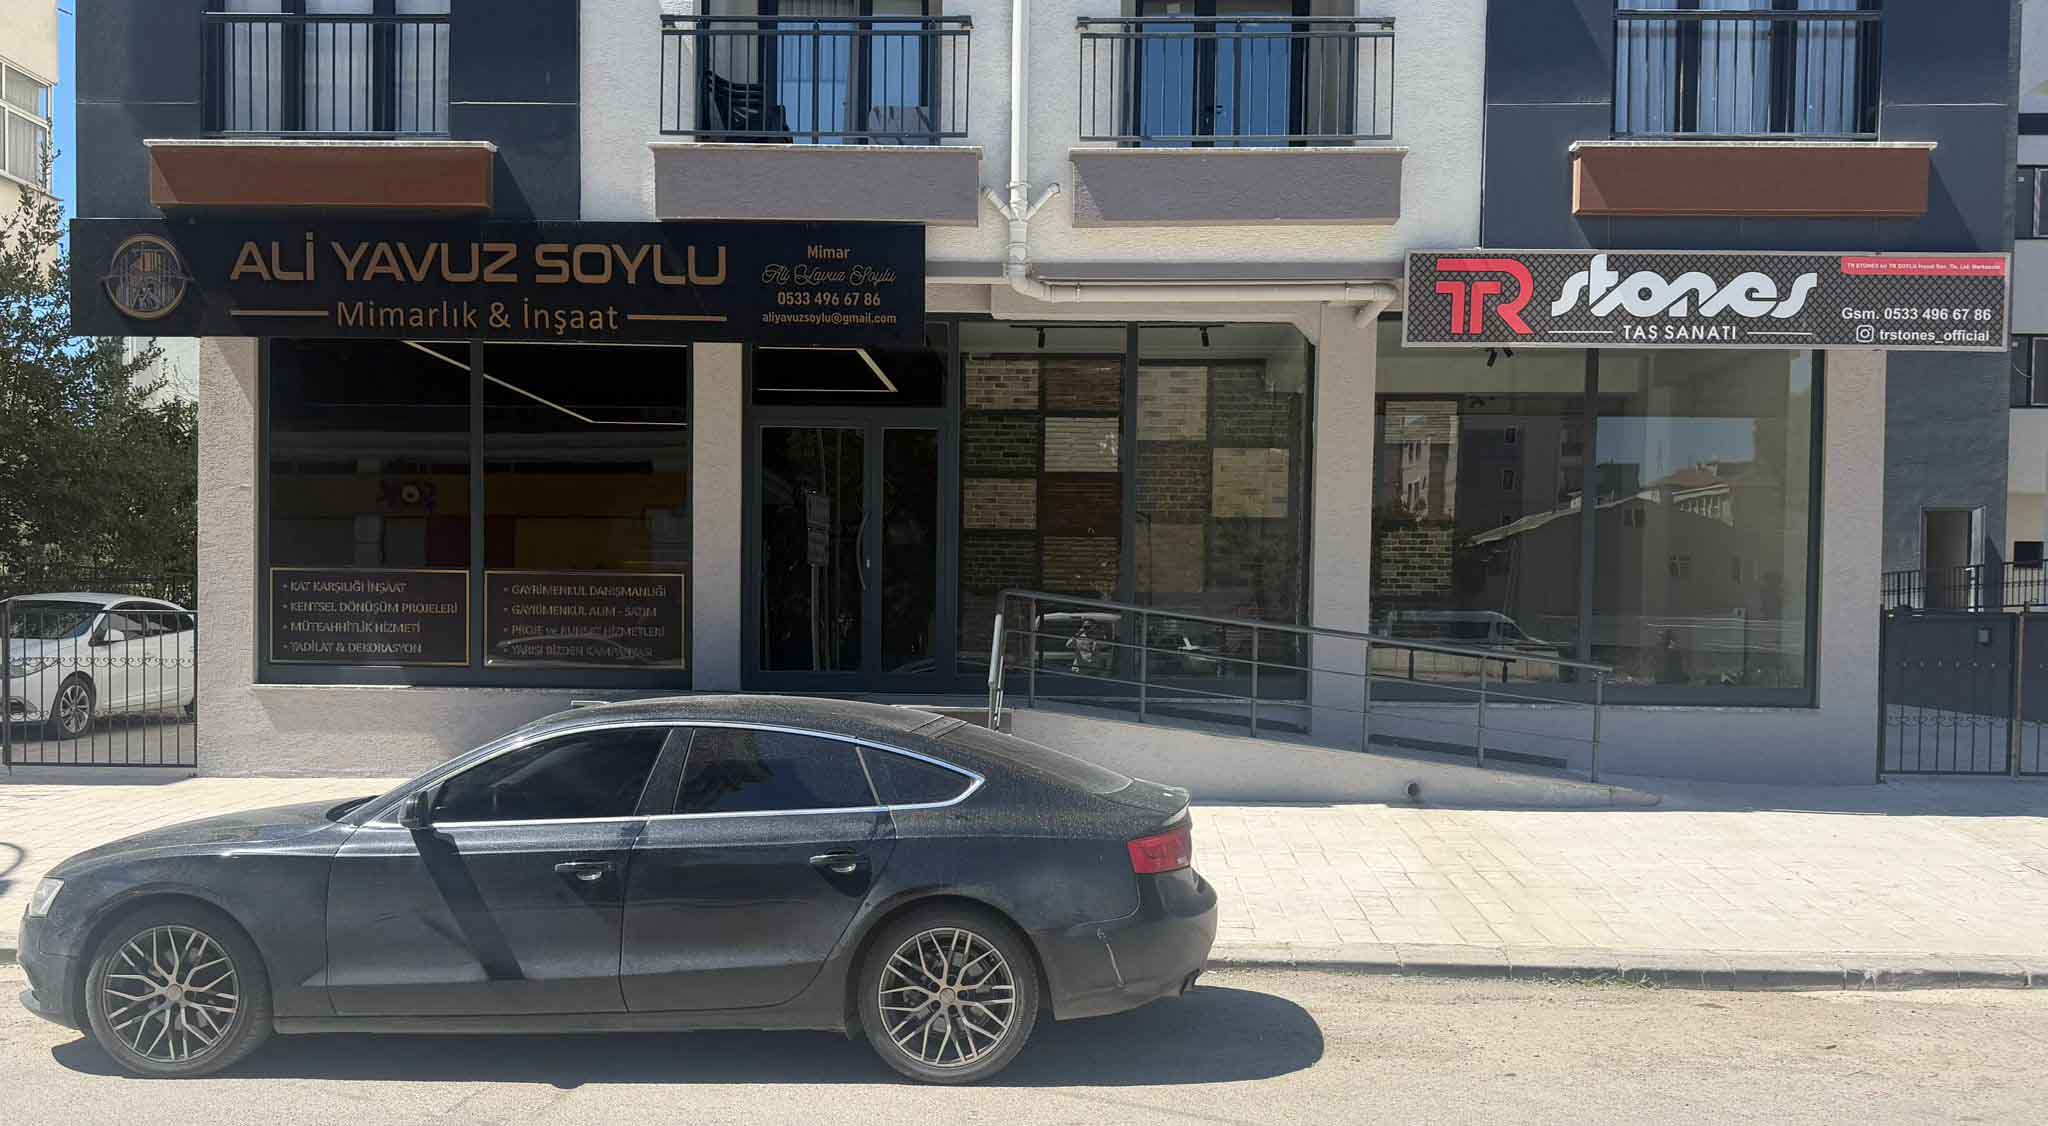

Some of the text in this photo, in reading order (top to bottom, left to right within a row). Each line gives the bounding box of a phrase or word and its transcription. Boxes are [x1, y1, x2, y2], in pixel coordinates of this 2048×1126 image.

[230, 232, 728, 286] ALİ YAVUZ SOYLU
[807, 245, 851, 260] Mimar
[777, 291, 881, 306] 0533 496 67 86
[1434, 253, 1818, 335] TR stones
[337, 297, 619, 335] Mimarlık & İnşaat
[761, 311, 897, 326] aliyavuzsoylu@gmail.com
[1841, 307, 1992, 321] Gsm. 0533 496 67 86
[1880, 330, 1989, 344] trstones_official
